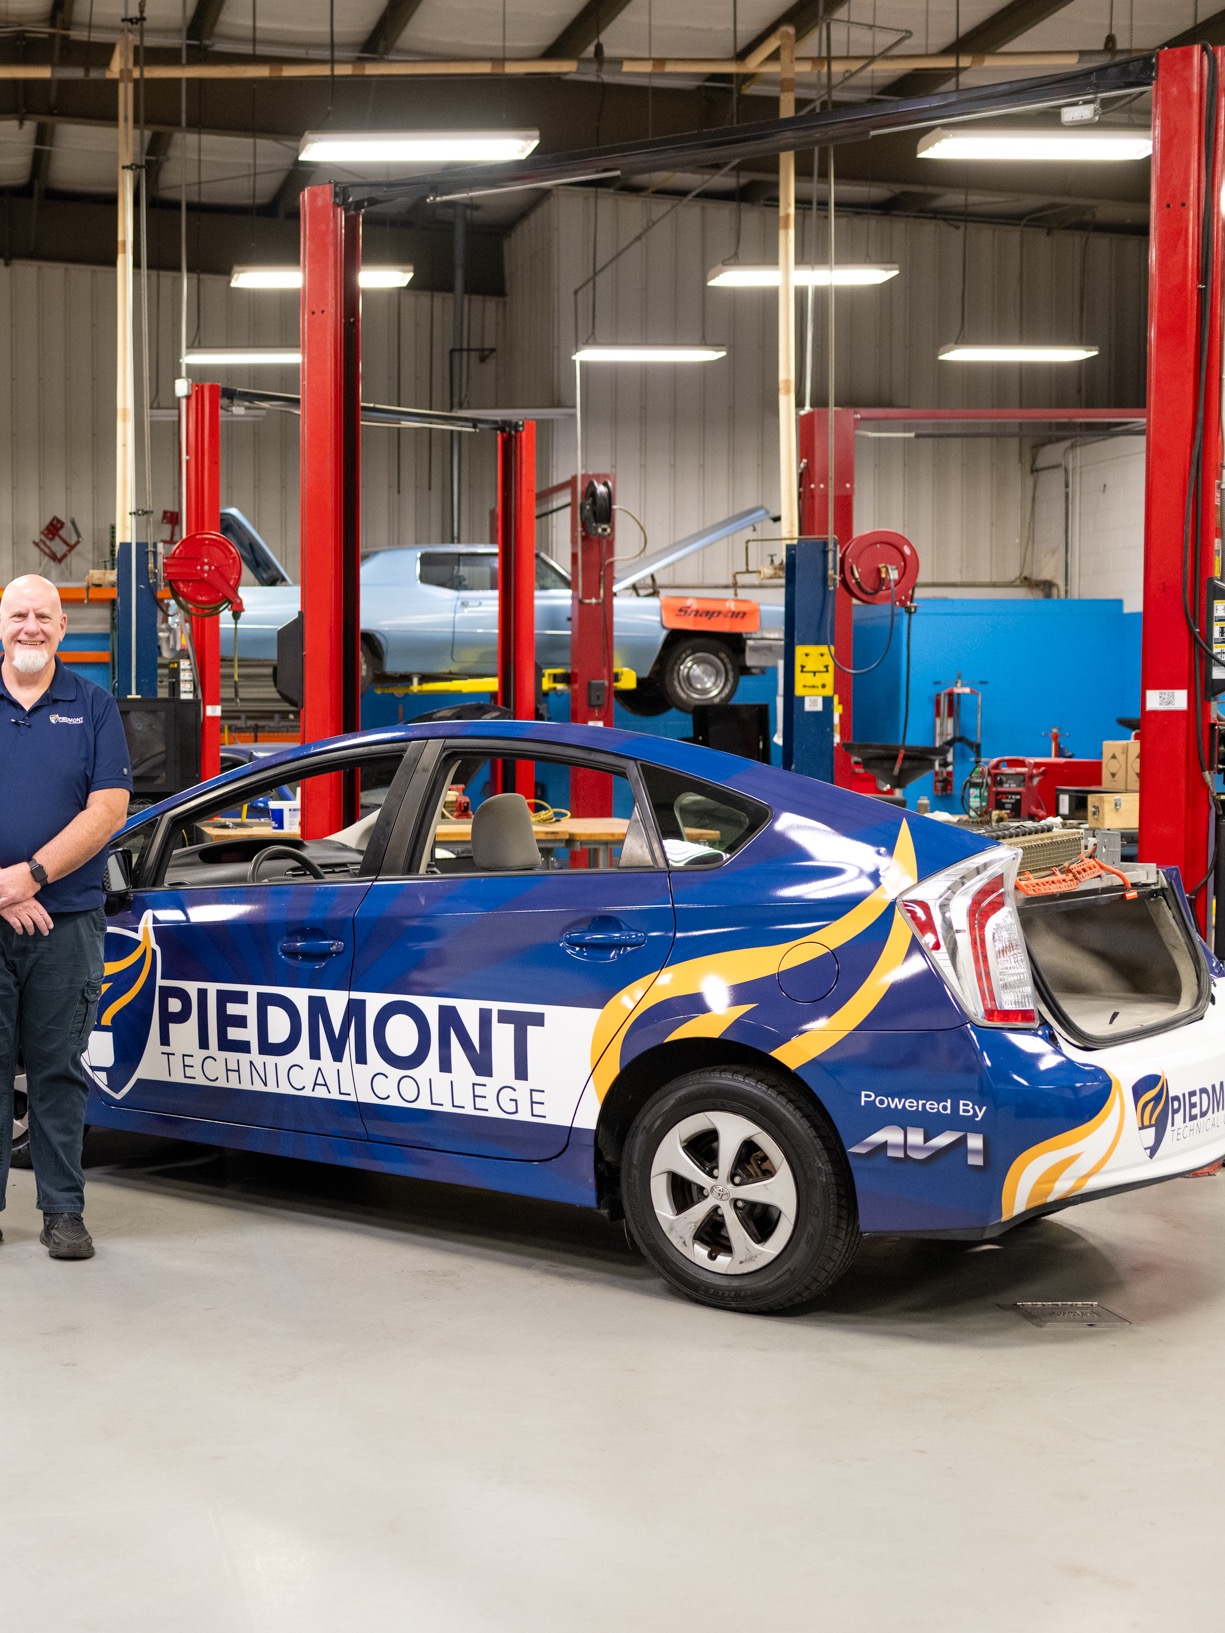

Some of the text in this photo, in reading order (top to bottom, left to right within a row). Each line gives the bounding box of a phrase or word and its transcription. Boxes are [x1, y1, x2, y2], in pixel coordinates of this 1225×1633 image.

[675, 606, 748, 620] Snap-on
[158, 985, 545, 1081] PIEDMONT
[161, 1052, 546, 1118] TECHNICAL COLLEGE
[860, 1090, 987, 1121] Powered By
[1171, 1116, 1220, 1143] TECHNICAL
